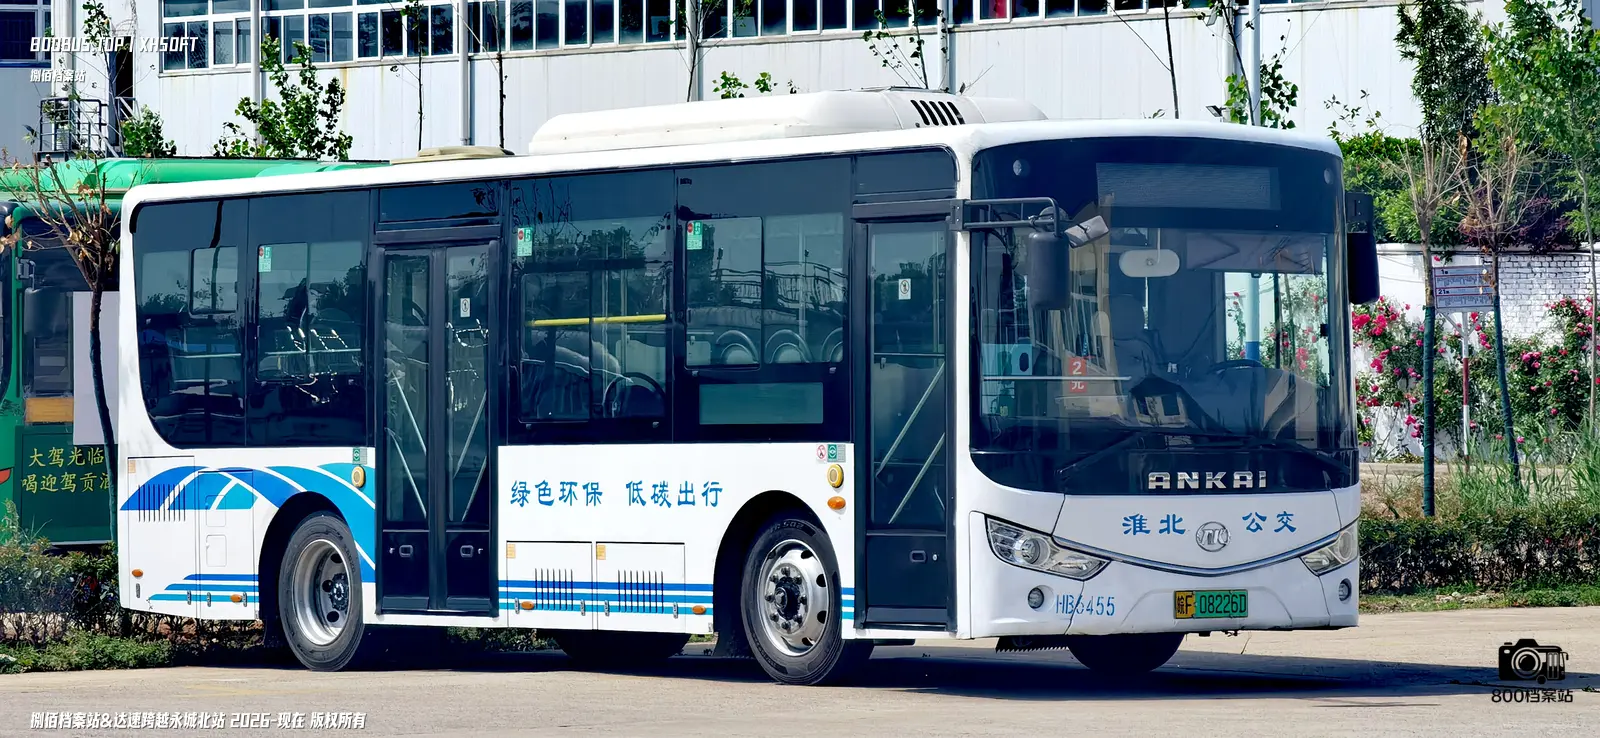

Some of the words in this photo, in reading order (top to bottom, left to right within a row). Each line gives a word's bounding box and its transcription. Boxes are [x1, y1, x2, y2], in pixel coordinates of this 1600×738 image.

[28, 446, 105, 468] 大驾光临
[1148, 470, 1267, 490] ANKAI
[510, 480, 603, 508] 绿色环保
[625, 480, 723, 508] 低碳出行
[1122, 513, 1186, 535] 淮北
[1241, 511, 1297, 533] 公交
[1055, 594, 1116, 617] HB6455
